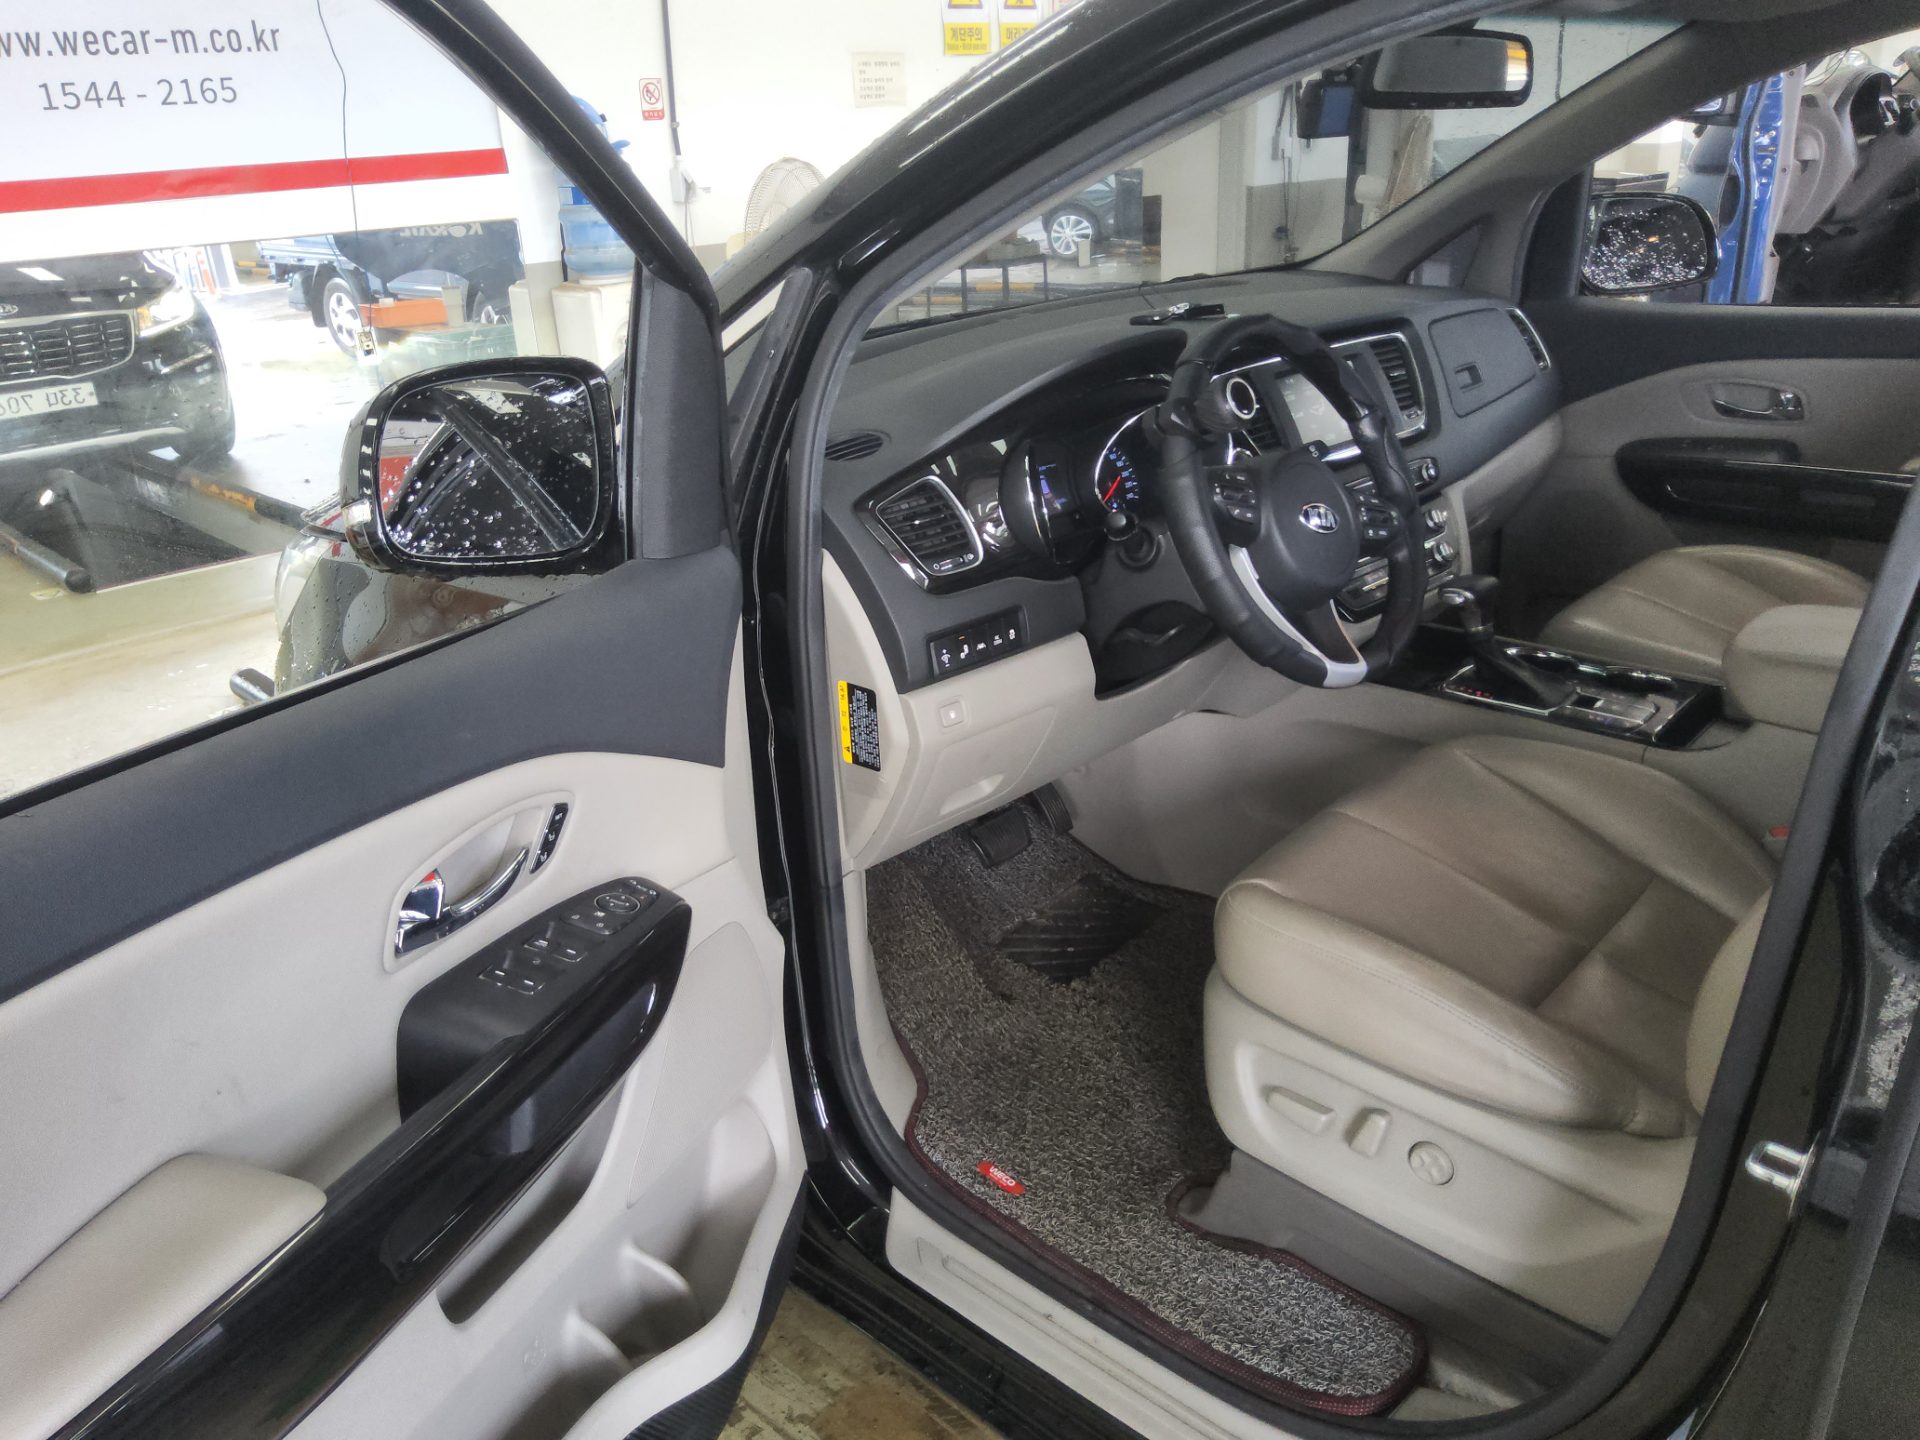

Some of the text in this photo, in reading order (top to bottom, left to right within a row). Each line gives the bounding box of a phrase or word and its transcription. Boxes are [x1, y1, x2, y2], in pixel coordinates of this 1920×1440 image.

[38, 80, 125, 110] 1544
[156, 77, 238, 106] 2165
[1306, 507, 1336, 528] KIA
[990, 1166, 1015, 1186] WECO
